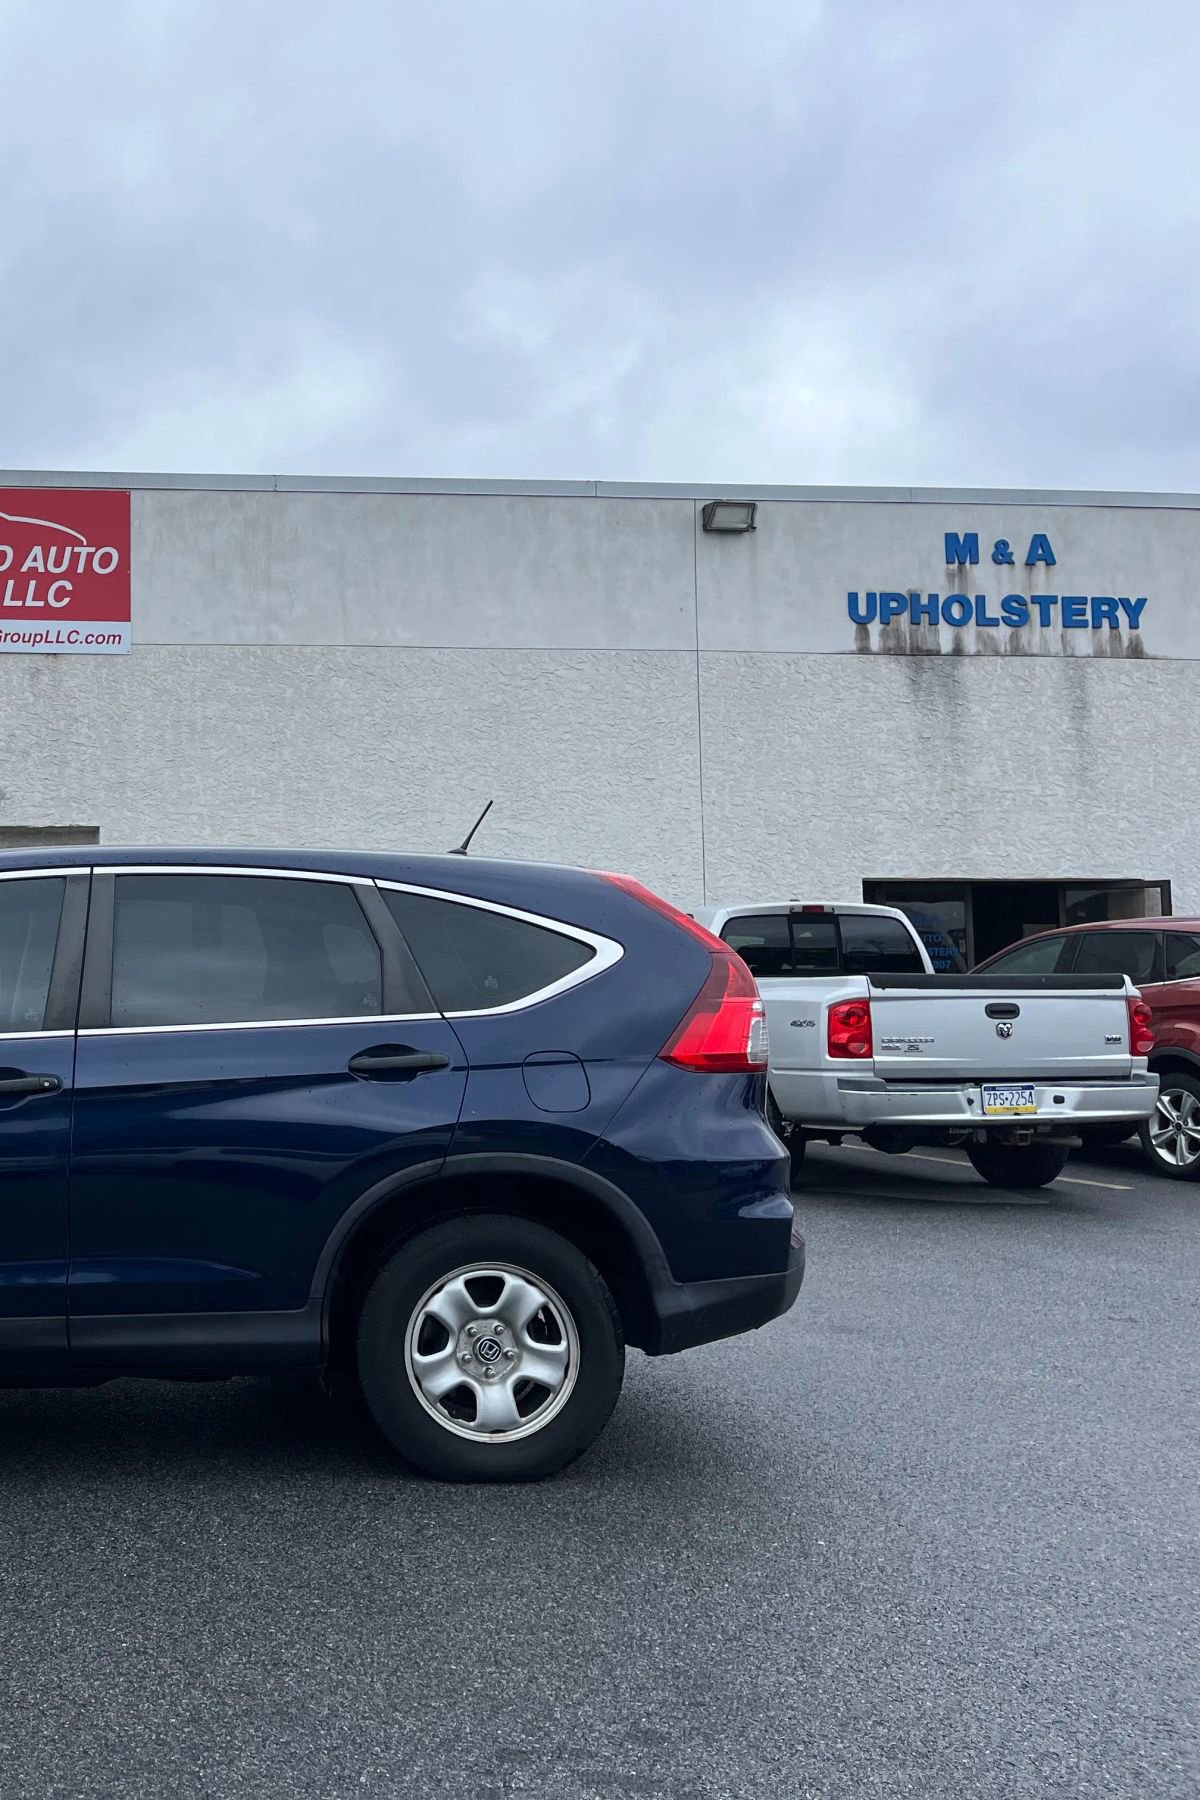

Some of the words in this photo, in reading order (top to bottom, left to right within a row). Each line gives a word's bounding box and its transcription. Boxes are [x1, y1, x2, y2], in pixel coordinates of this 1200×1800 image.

[21, 546, 118, 574] AUTO
[944, 532, 980, 563] M
[991, 539, 1015, 565] &
[1025, 533, 1057, 566] A
[3, 580, 72, 607] LLC
[848, 592, 1147, 628] UPHOLSTERY
